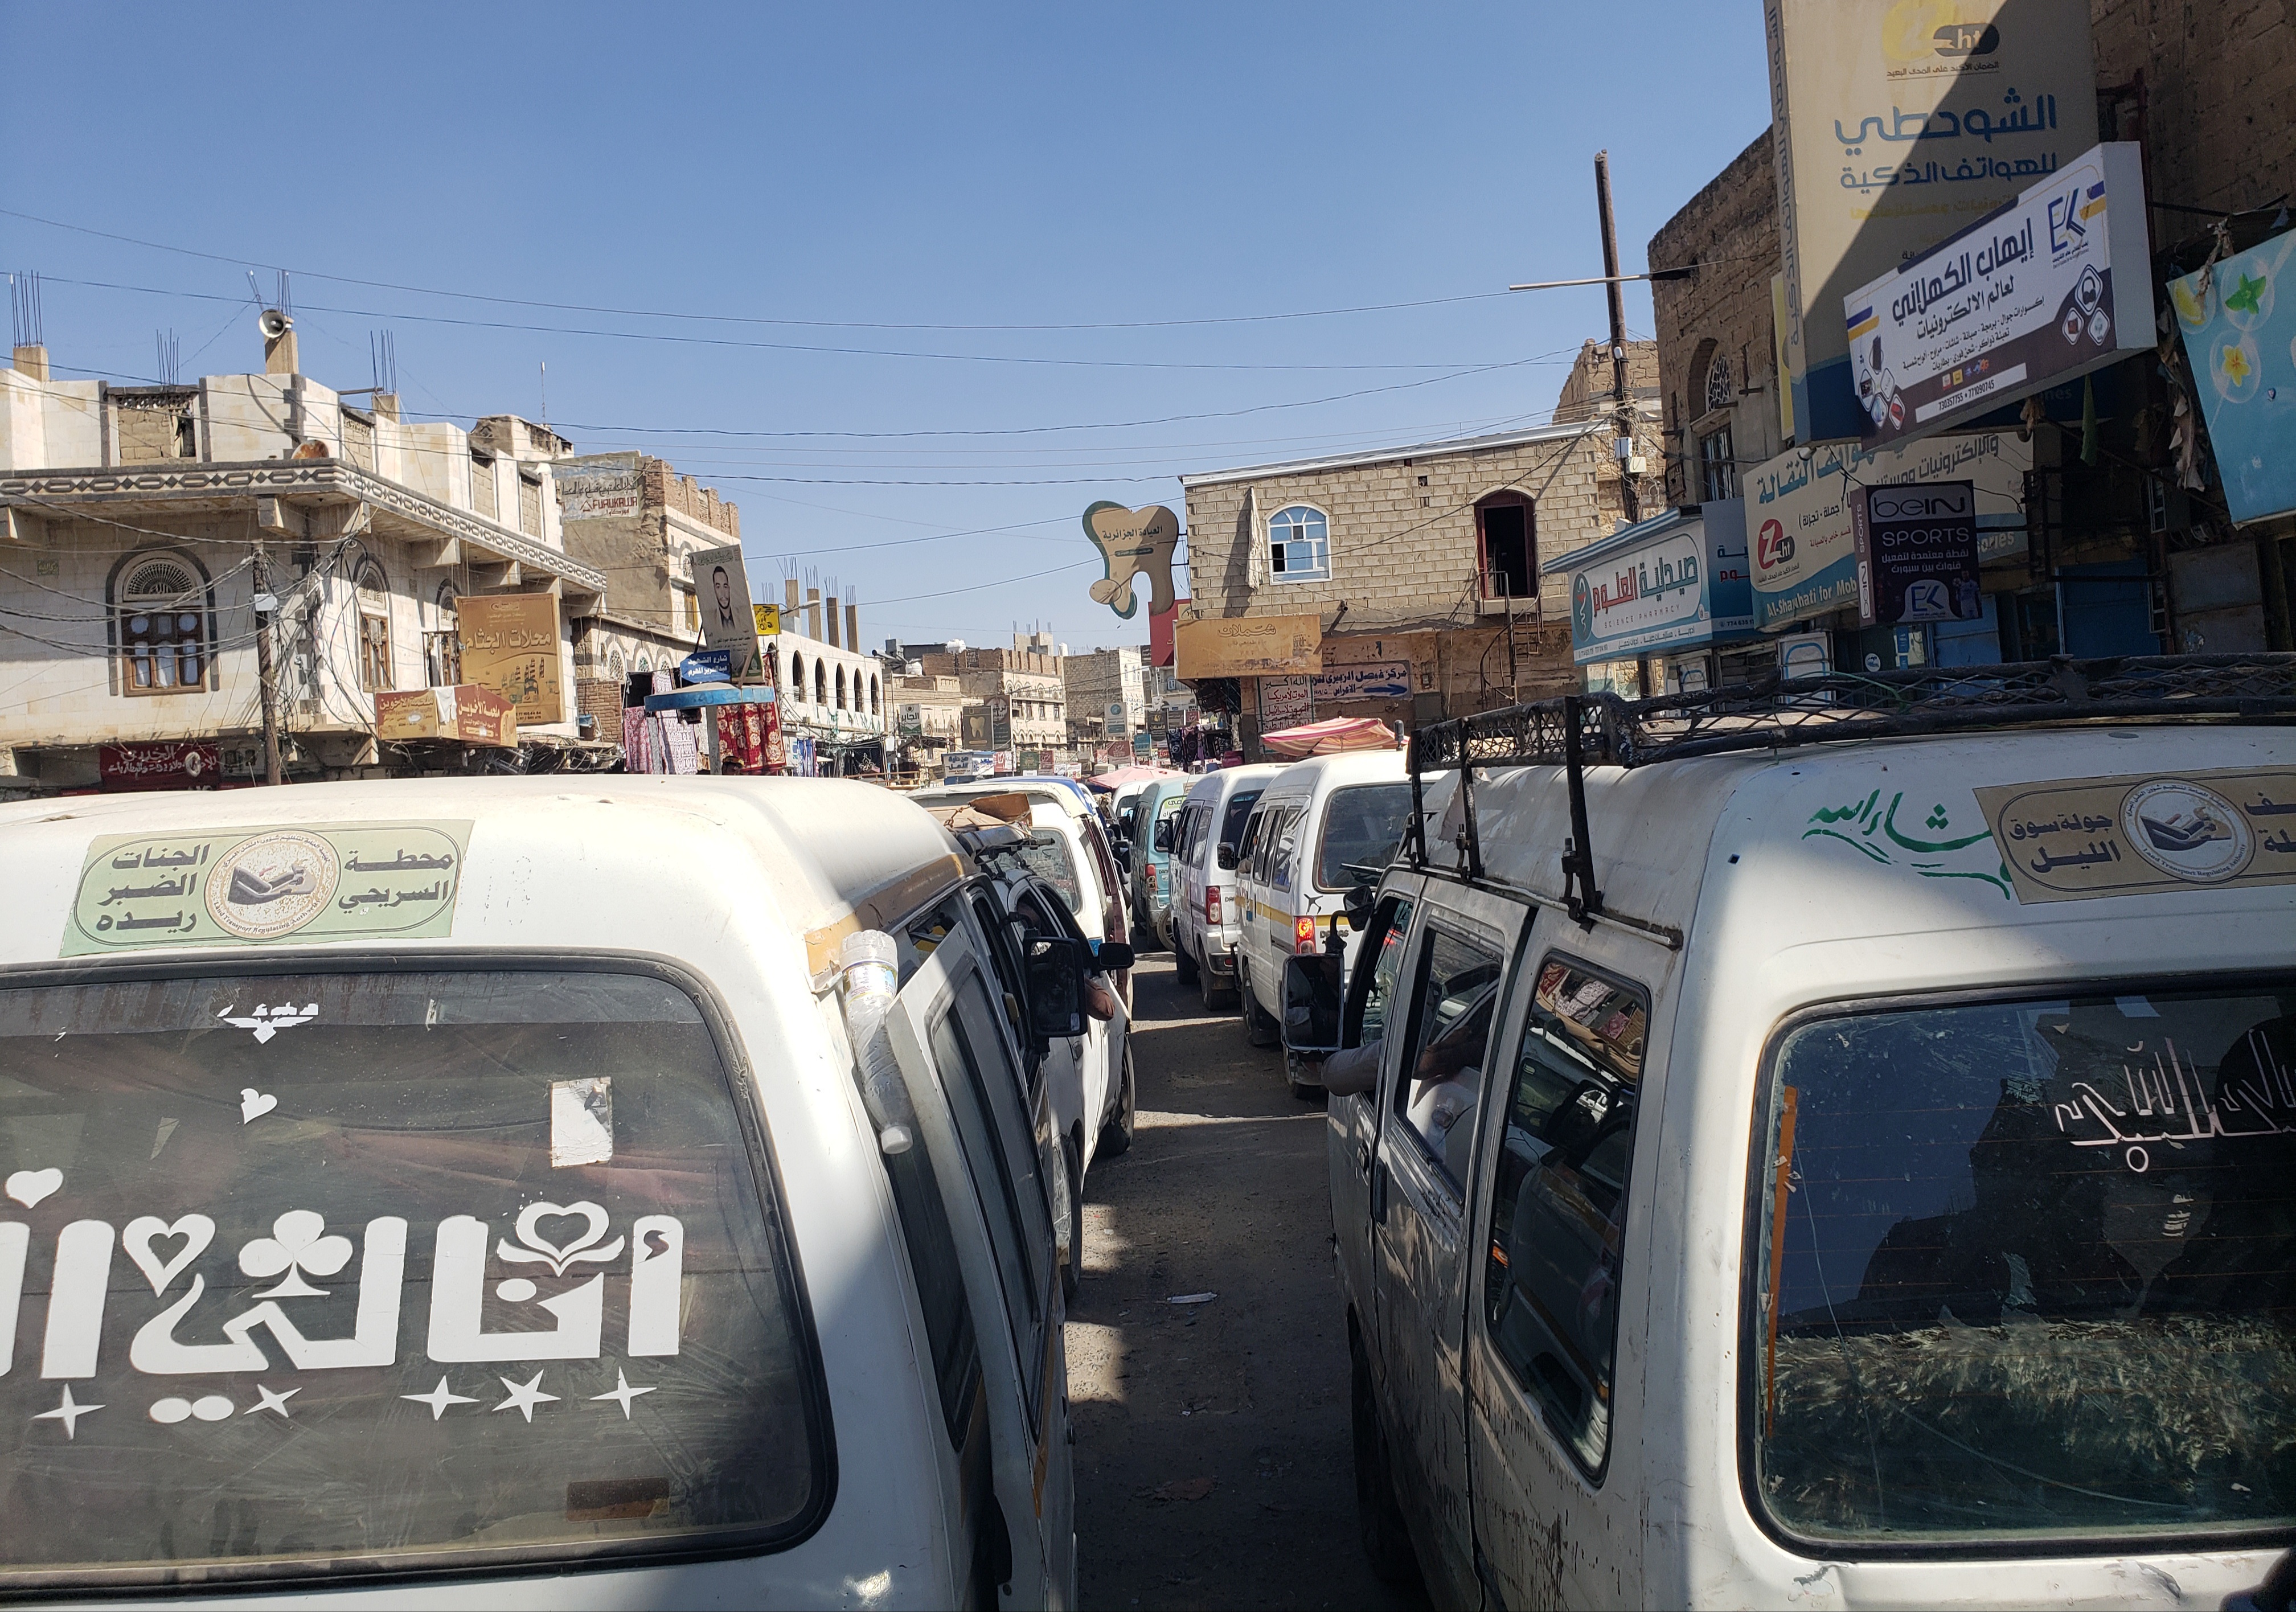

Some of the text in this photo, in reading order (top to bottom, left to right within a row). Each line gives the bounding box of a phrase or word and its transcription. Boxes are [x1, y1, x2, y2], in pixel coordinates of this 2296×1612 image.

[1834, 87, 2056, 157] الشوحطي
[1840, 152, 2056, 194] للهواتف الذكية
[1977, 217, 2035, 282] إيهاب
[1785, 247, 1799, 346] الذكية
[1892, 252, 1973, 327] الكهلاني
[1987, 274, 2015, 311] لعالم
[2000, 313, 2014, 326] جوال
[1757, 456, 1815, 504] النقالة
[593, 497, 638, 510] FURUKAWA
[1102, 525, 1163, 543] العيادة الجزائرية
[1881, 527, 1970, 547] SPORTS
[1881, 548, 1969, 564] نقطة معتمدة لتفعيل
[1936, 560, 1961, 572] قنوات
[1593, 556, 1699, 618] صيدلية العلوم
[1819, 585, 1832, 602] for
[1836, 577, 1858, 597] Mob
[1604, 604, 1680, 629] SCIENCE PHARMACY
[509, 628, 551, 649] محلات
[688, 654, 728, 666] شارع الشهيد
[1293, 675, 1307, 687] الله
[1355, 669, 1384, 682] فيصل
[1385, 668, 1407, 680] مركز
[409, 695, 434, 707] ملحمة
[1267, 687, 1292, 702] لأمريكا
[1293, 689, 1309, 700] الموت
[483, 701, 500, 718] ملحمة
[2008, 811, 2113, 840] جولة سوق
[112, 843, 455, 872] الجنات محطة
[2030, 840, 2122, 873] الليل
[2143, 848, 2160, 864] Land
[2161, 860, 2196, 876] Transport
[2196, 866, 2232, 877] Regulating
[97, 872, 450, 914] الضبر السريحي
[96, 909, 198, 934] ريده
[213, 901, 224, 917] Land
[223, 914, 252, 932] Transport
[252, 921, 290, 933] Regulating
